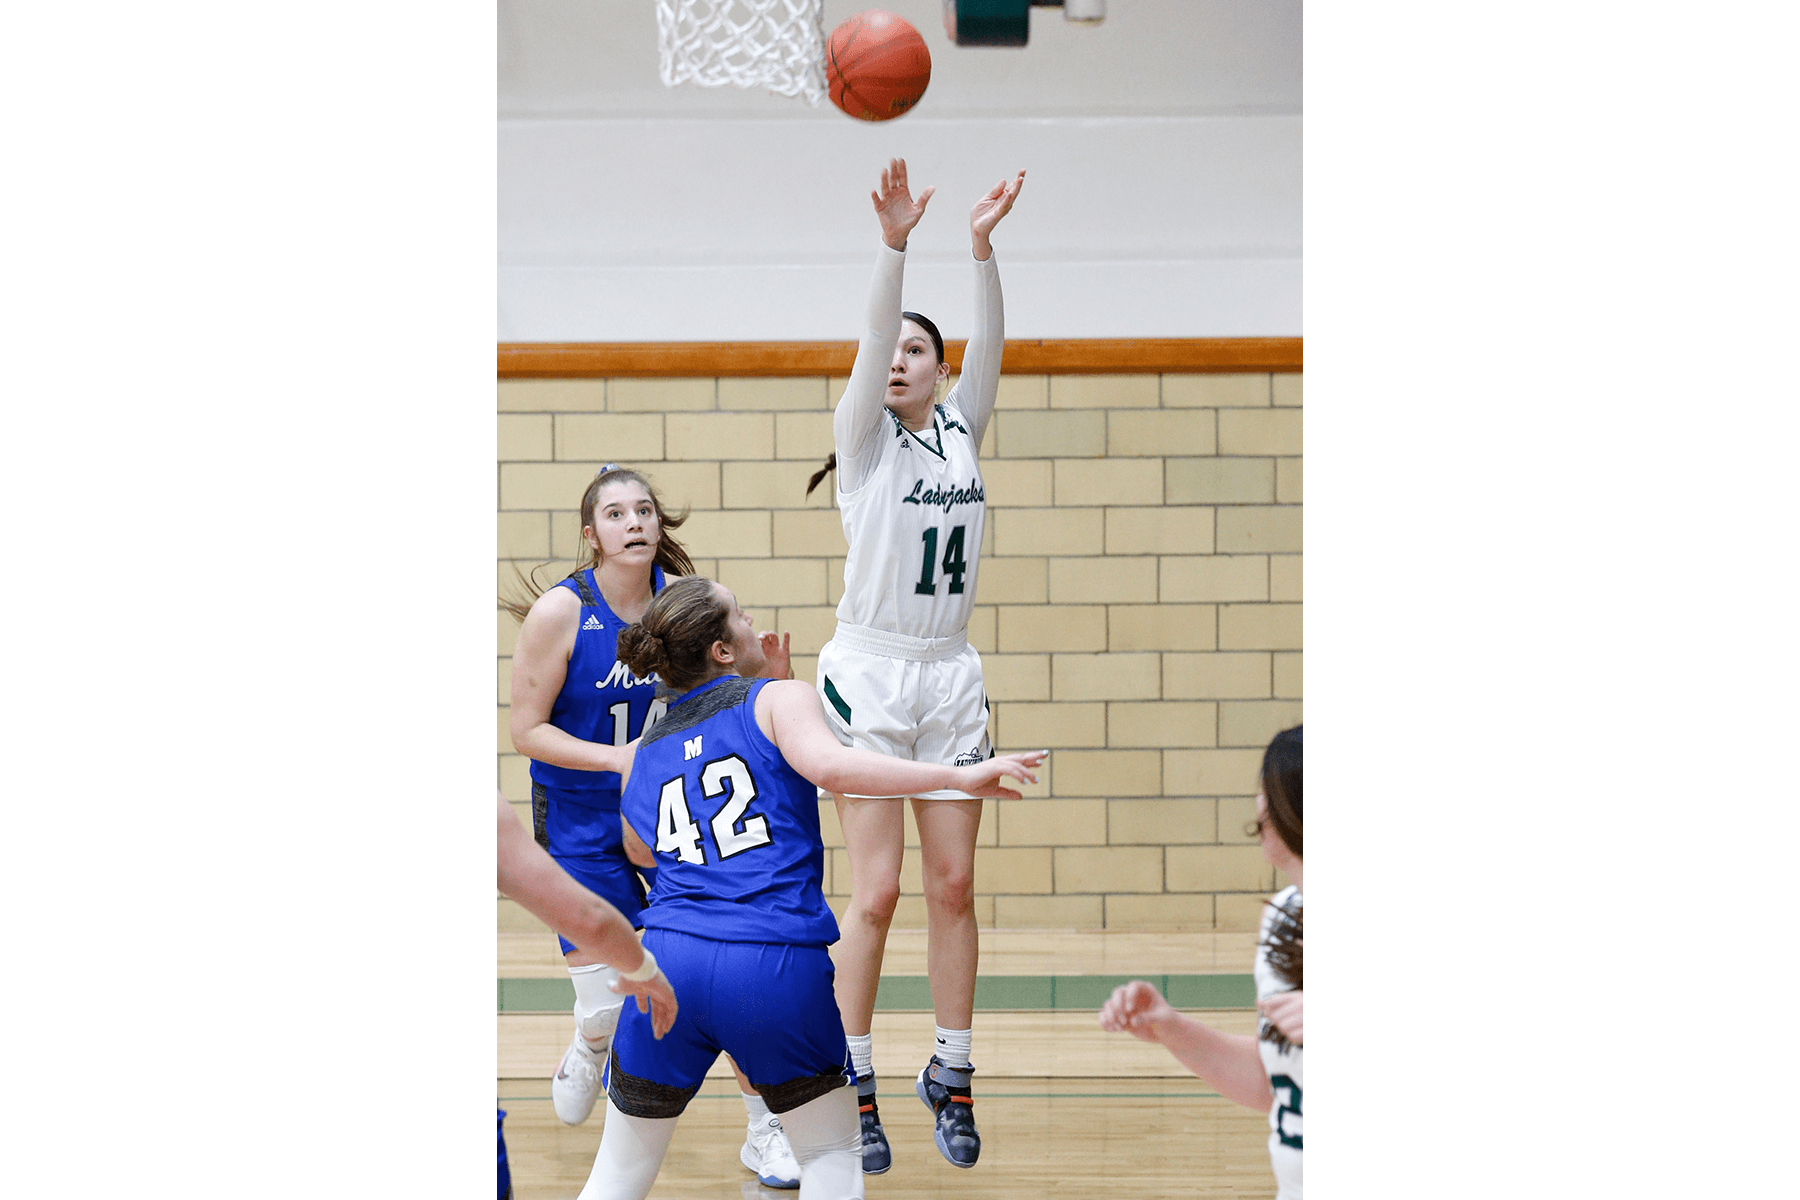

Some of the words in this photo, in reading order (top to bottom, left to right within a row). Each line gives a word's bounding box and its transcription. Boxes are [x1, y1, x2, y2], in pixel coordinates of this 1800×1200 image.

[914, 525, 967, 596] 14
[683, 734, 703, 761] M
[654, 752, 775, 866] 42
